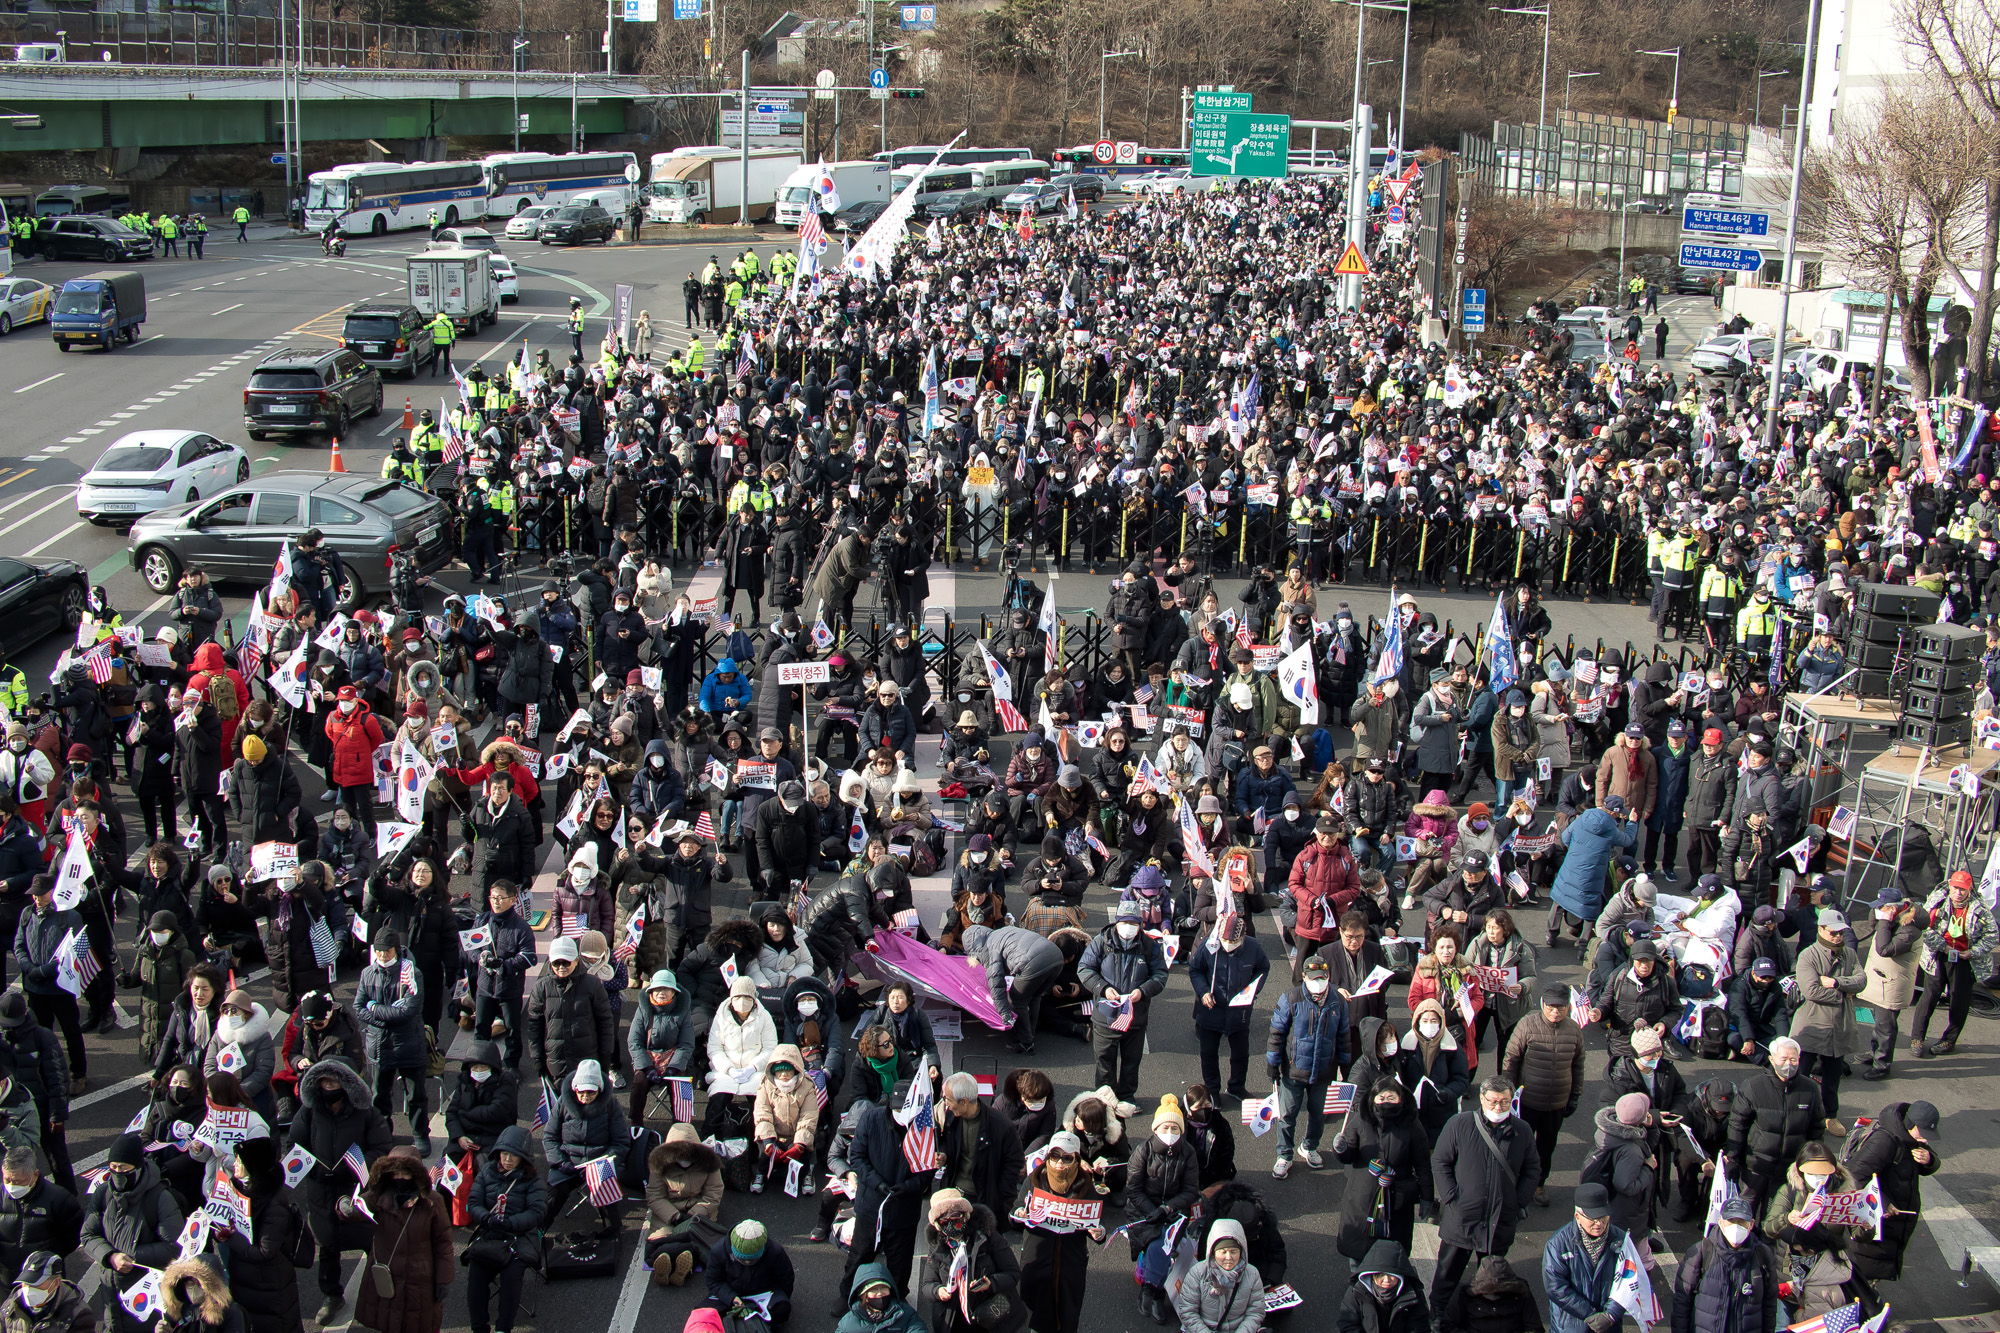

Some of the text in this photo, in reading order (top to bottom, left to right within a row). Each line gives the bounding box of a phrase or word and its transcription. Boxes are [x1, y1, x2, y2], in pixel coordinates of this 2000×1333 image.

[1198, 96, 1248, 108] 북한남삼거리
[1196, 113, 1227, 122] 용산구청
[1250, 123, 1287, 133] 장충체육관
[1195, 130, 1226, 139] 이태원역
[1249, 140, 1274, 150] 약수역
[1098, 146, 1111, 158] 50
[1694, 211, 1751, 225] 한남대로46길
[1689, 222, 1752, 234] Hannam-daero 46-gil
[1684, 246, 1741, 261] 한남대로42길
[1682, 258, 1750, 270] Hannam-daero 42-gil
[694, 600, 718, 611] 탄핵반대
[782, 665, 826, 681] 충북(청주)
[738, 764, 777, 775] 탄핵반대
[739, 776, 763, 785] 이재명
[1515, 834, 1554, 845] 탄핵반대
[1474, 966, 1509, 979] STOP
[1481, 975, 1505, 986] THE
[1480, 984, 1514, 998] TEAL
[207, 1107, 248, 1127] 탄반대
[213, 1180, 250, 1217] 탄핵반대
[1826, 1193, 1862, 1205] TOP
[1033, 1196, 1101, 1218] 탄핵반대
[1822, 1206, 1854, 1215] THE
[1043, 1216, 1070, 1228] 재명
[1820, 1214, 1862, 1224] TEAL
